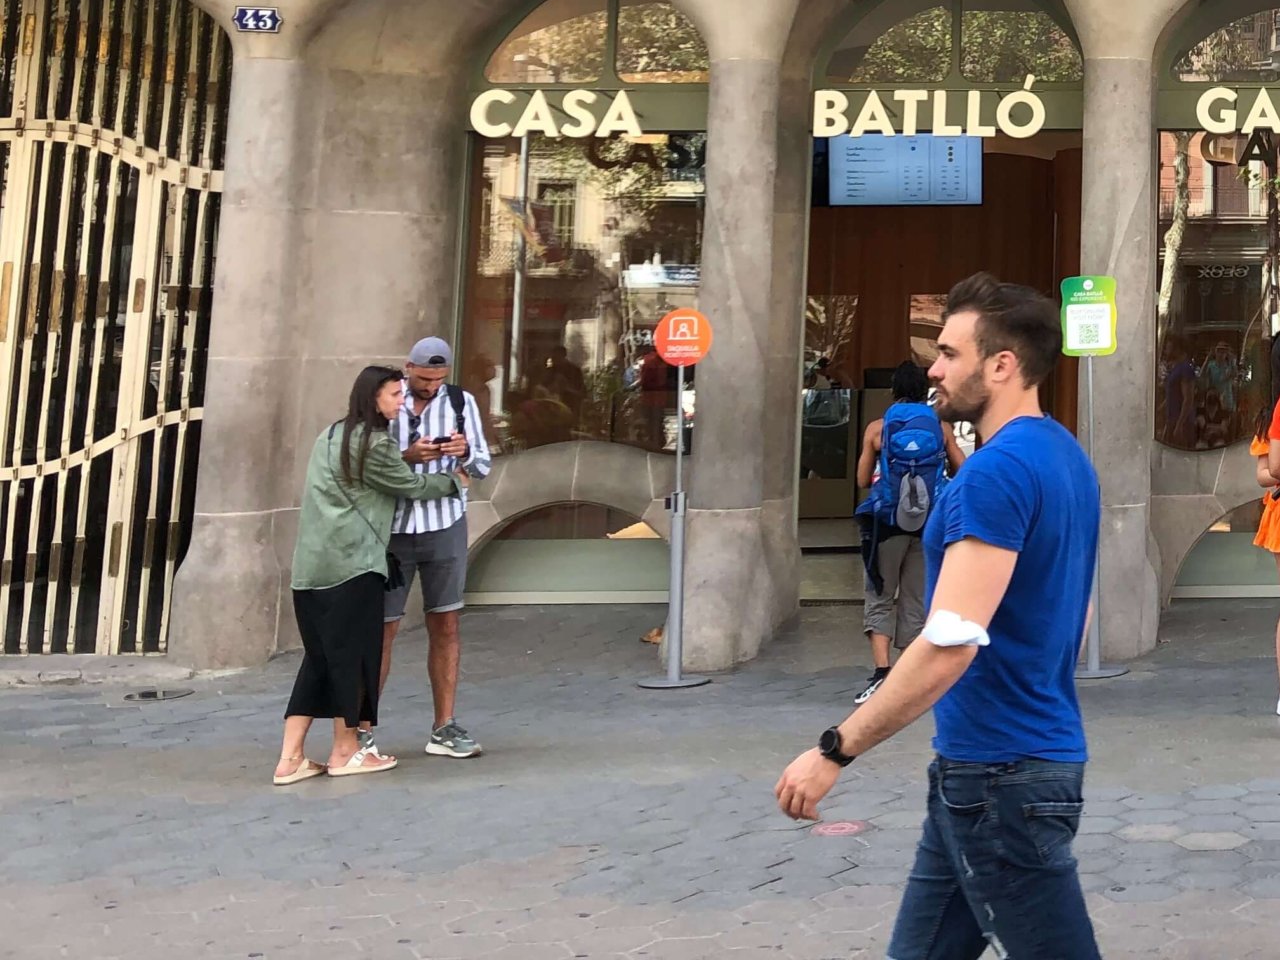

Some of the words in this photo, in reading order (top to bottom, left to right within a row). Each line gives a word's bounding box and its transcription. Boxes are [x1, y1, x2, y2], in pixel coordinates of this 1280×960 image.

[242, 9, 273, 30] 43
[469, 88, 642, 138] CASA
[812, 73, 1046, 138] BATLLÓ
